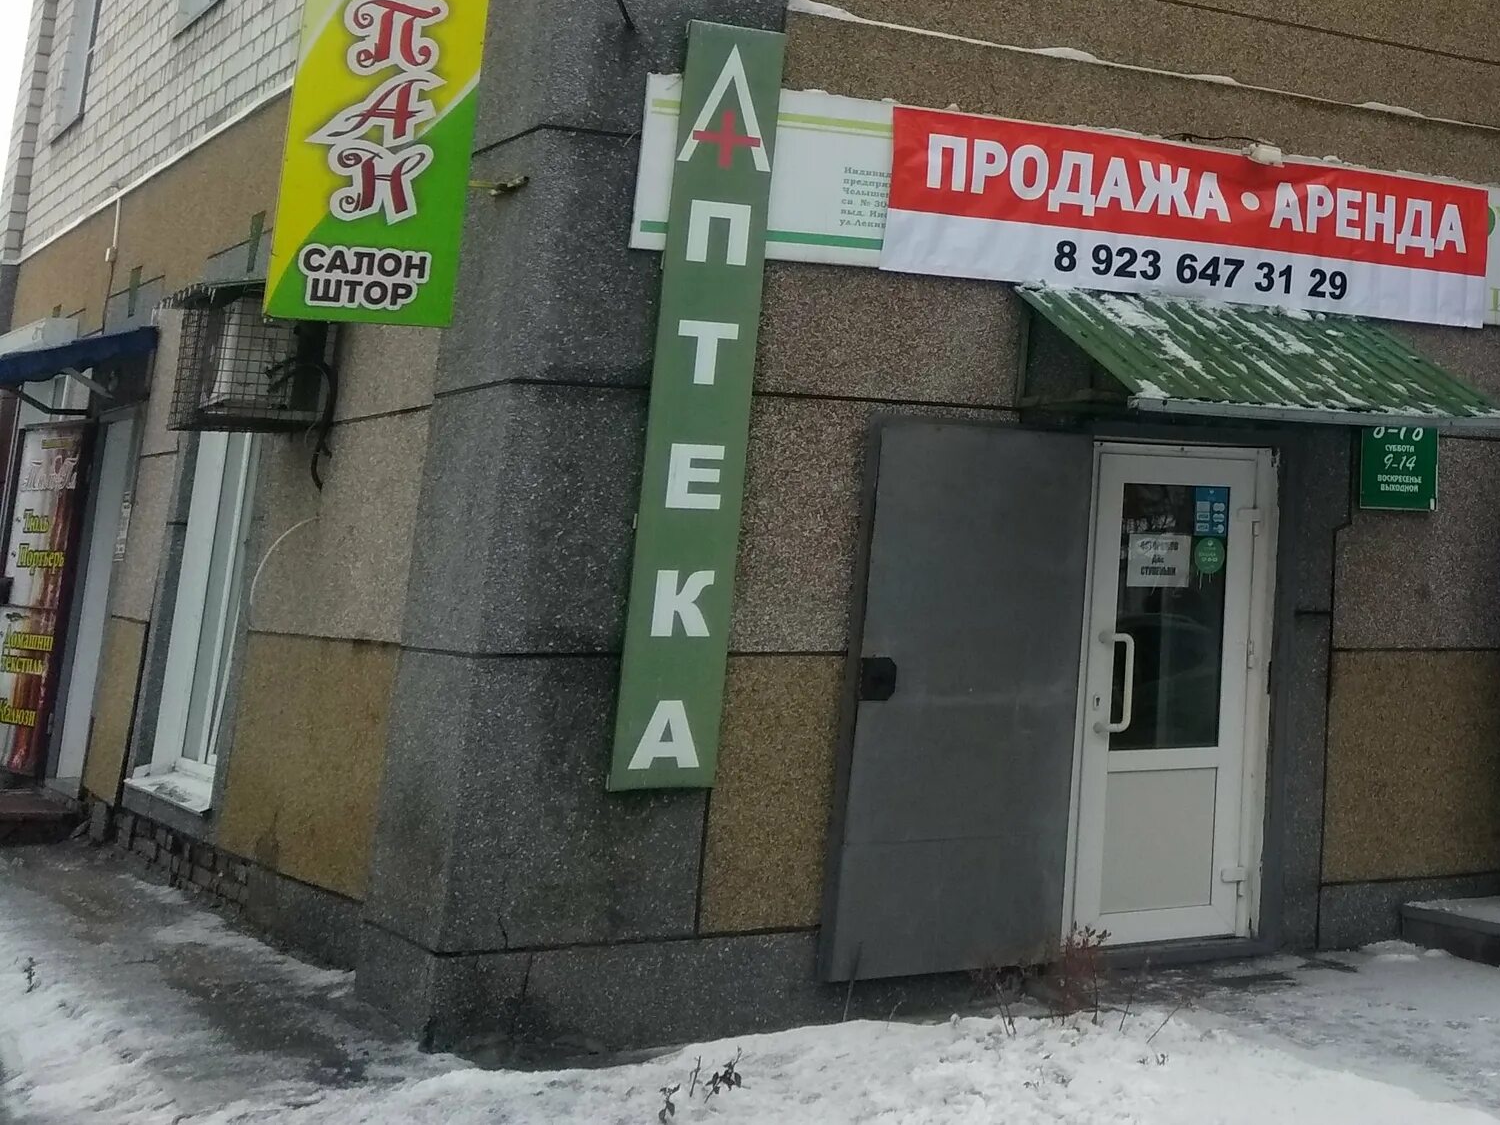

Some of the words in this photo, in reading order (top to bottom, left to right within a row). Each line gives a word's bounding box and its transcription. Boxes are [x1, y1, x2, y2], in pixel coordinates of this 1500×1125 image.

[926, 132, 1232, 223] ПРОДАЖА
[1269, 181, 1467, 259] АРЕНДА
[302, 247, 428, 281] САЛОН
[1054, 240, 1077, 273] 8
[1091, 244, 1162, 281] 923
[1176, 249, 1245, 289] 647
[1254, 261, 1292, 295] 31
[1308, 268, 1348, 301] 29
[311, 279, 414, 308] ШТОР
[629, 43, 771, 770] АПТЕКА
[1383, 453, 1417, 471] 9-14
[1385, 444, 1415, 453] СУББОТА
[1377, 474, 1422, 484] ВОСКРЕСЕНЬЕ
[1380, 483, 1419, 493] ВЫХОДНОЙ
[23, 508, 50, 534] Тюль
